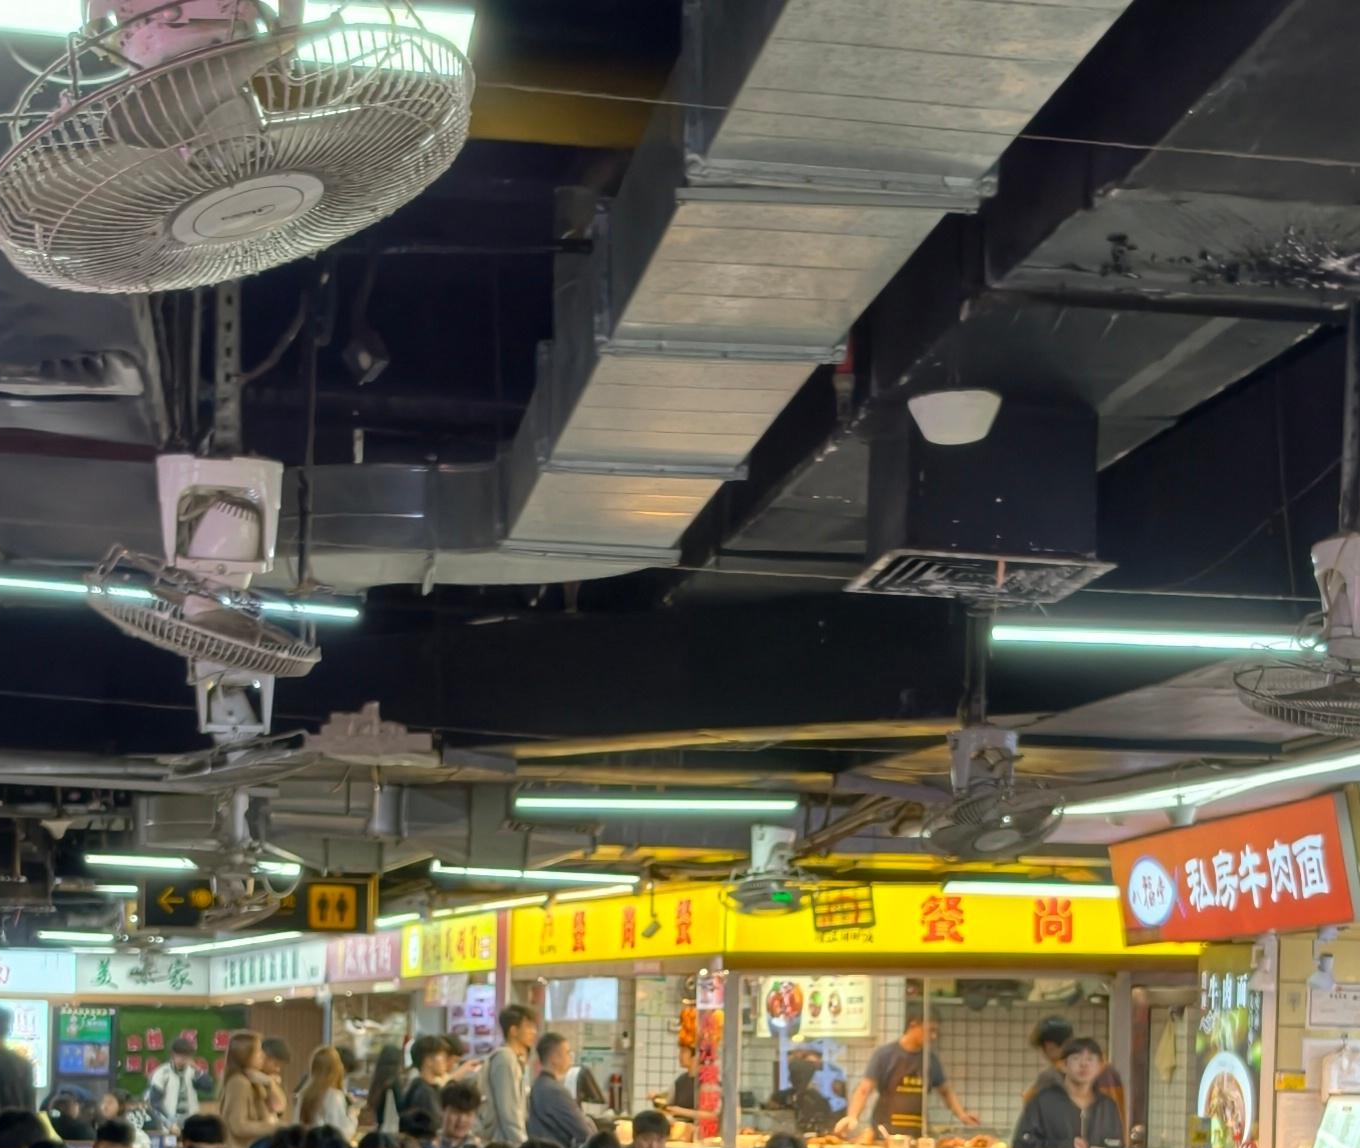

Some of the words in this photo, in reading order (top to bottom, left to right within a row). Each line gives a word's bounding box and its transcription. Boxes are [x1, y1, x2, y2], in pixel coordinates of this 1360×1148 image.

[1185, 832, 1330, 912] 私房牛肉面
